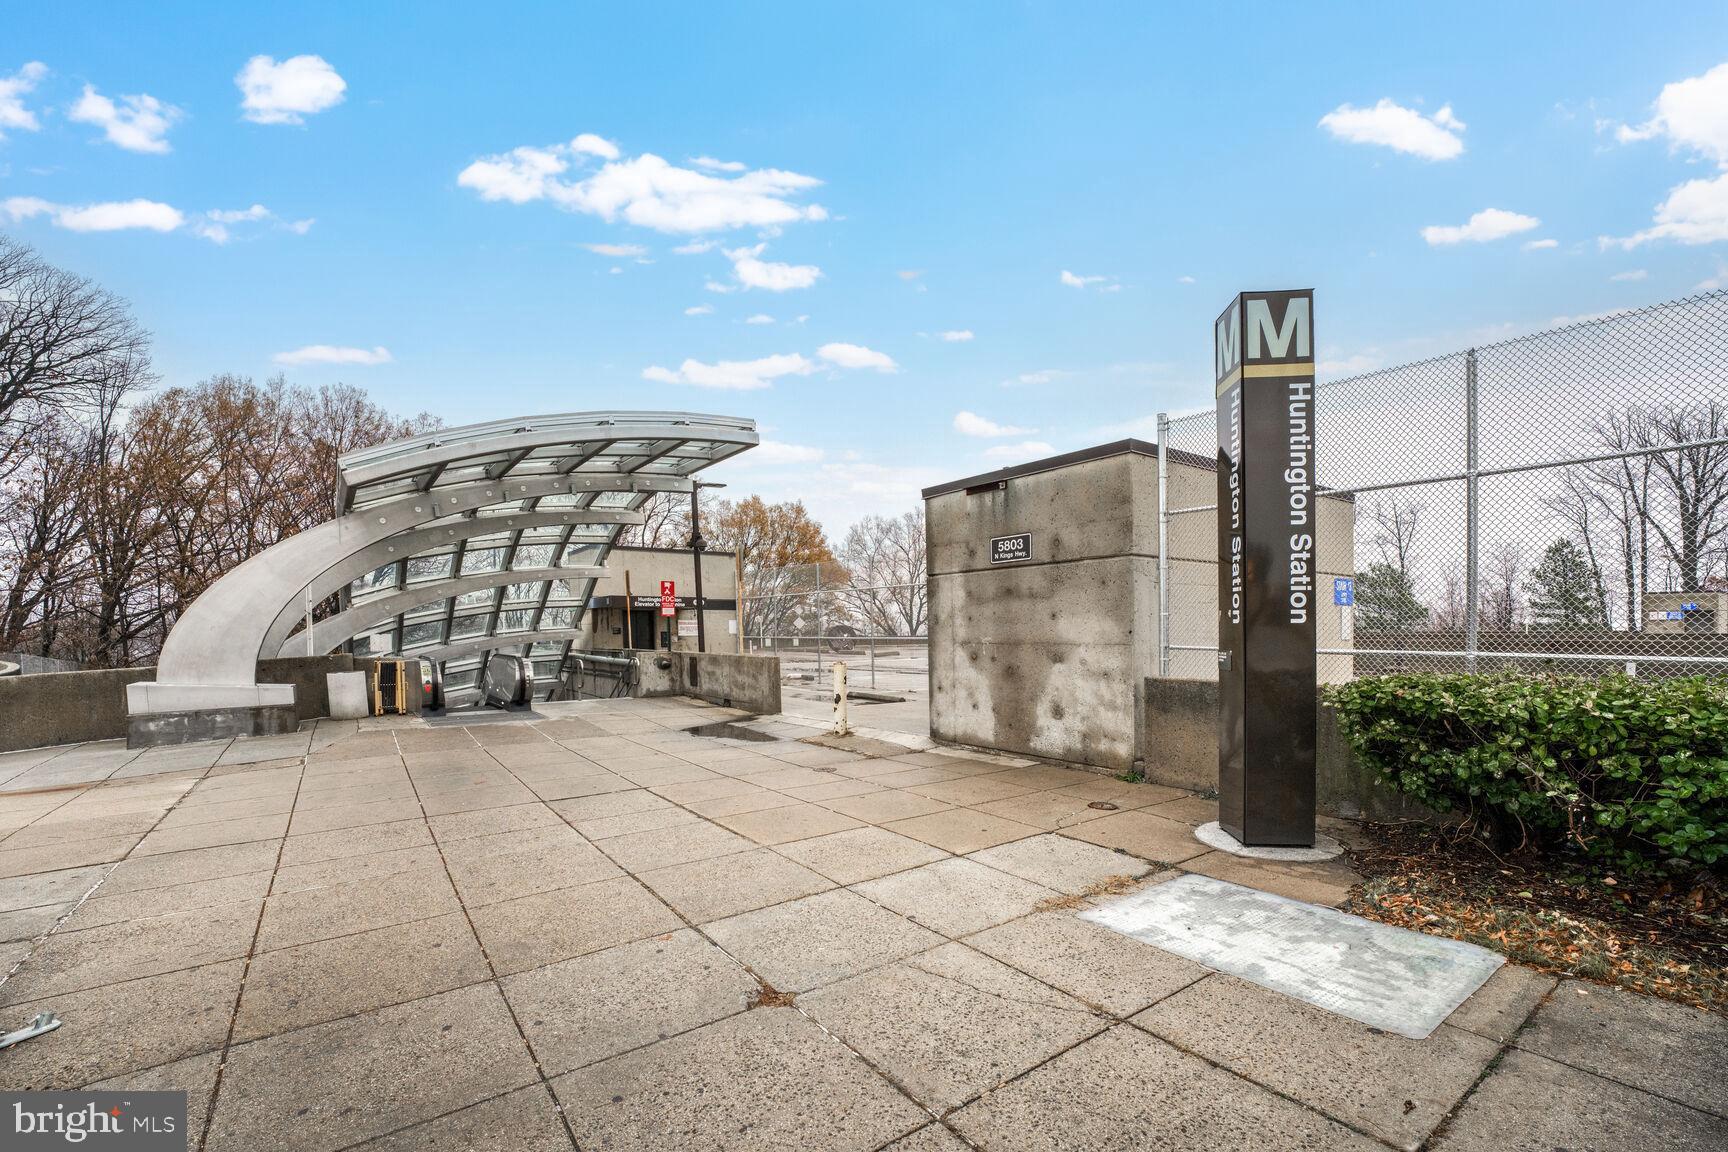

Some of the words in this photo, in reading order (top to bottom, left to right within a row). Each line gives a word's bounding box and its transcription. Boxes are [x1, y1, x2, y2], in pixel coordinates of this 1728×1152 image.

[1217, 303, 1240, 380] M
[1246, 297, 1310, 359] M
[1229, 387, 1241, 529] Huntington
[1284, 382, 1312, 525] Huntington
[998, 538, 1023, 552] 5803
[1232, 536, 1242, 624] Station
[1290, 533, 1313, 624] Station
[661, 595, 675, 603] FDC
